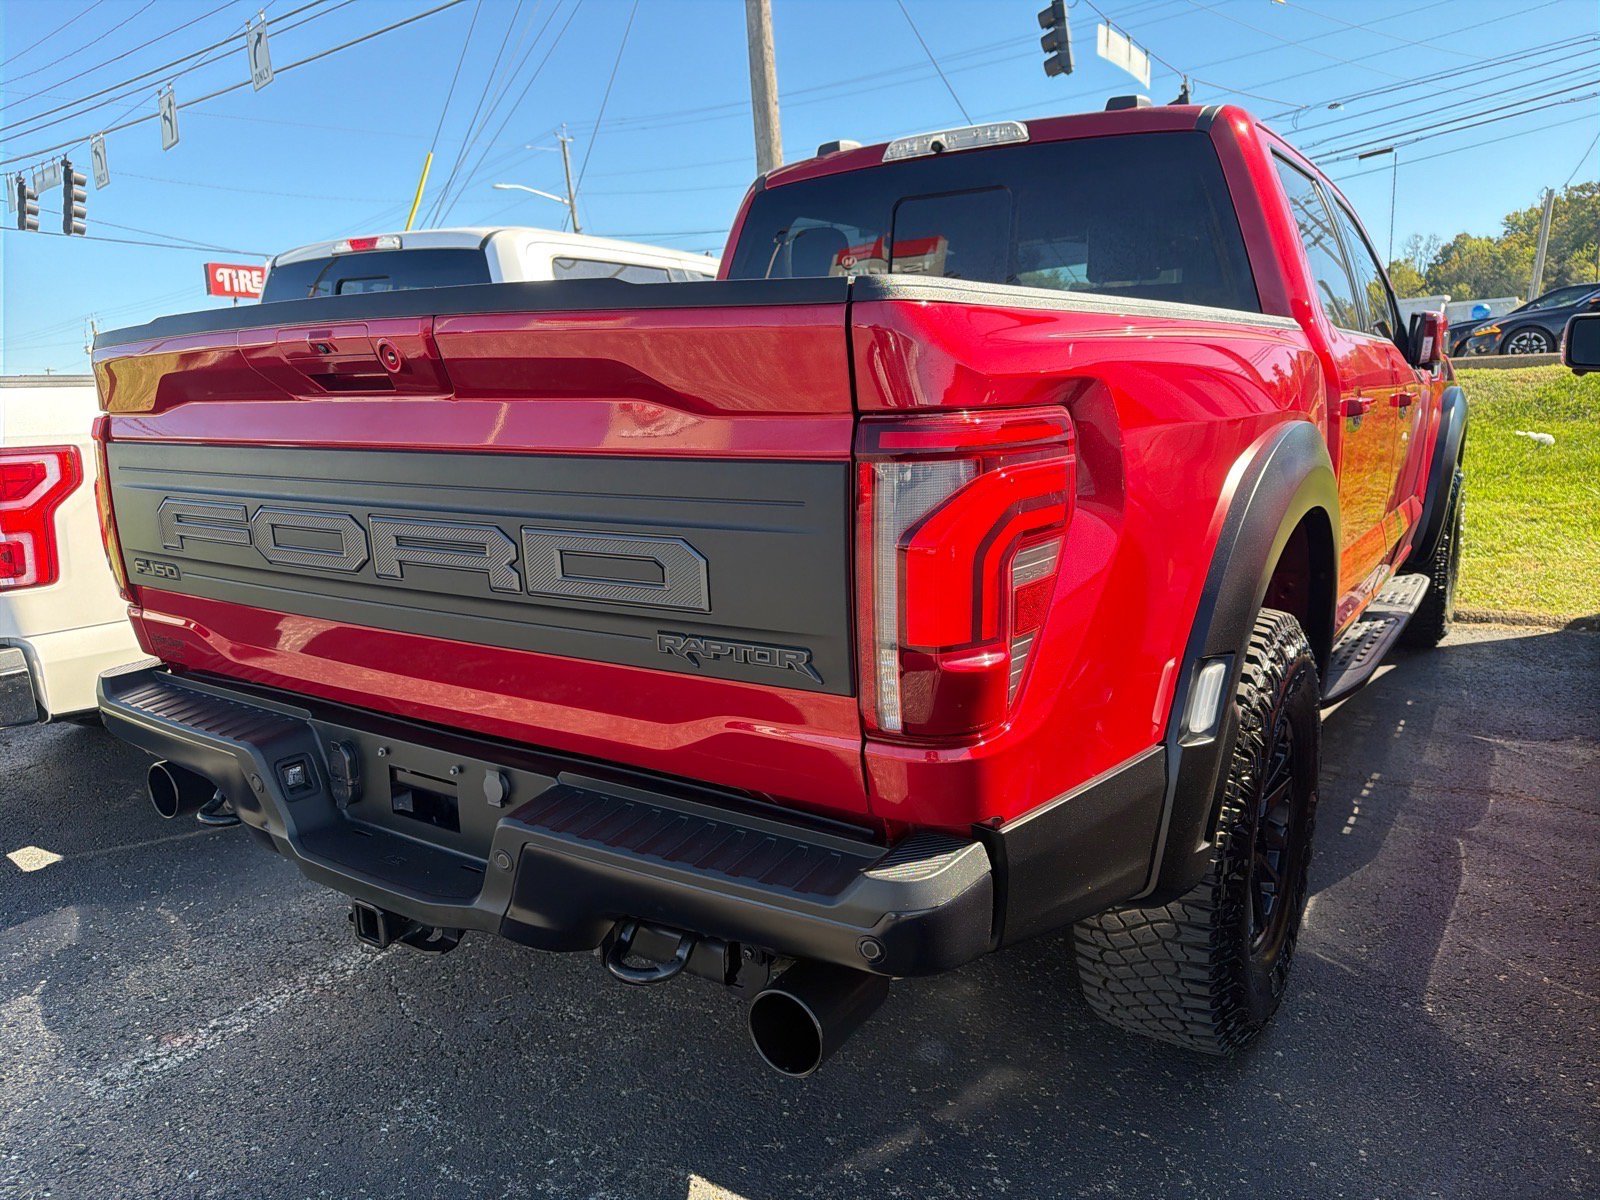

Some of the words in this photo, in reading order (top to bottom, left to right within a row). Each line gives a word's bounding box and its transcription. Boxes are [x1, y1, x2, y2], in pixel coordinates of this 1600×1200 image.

[255, 65, 270, 85] ONLY
[215, 267, 262, 294] TIRE
[157, 496, 711, 614] FORD
[134, 558, 181, 581] F-150
[657, 630, 825, 685] RAPTOR
